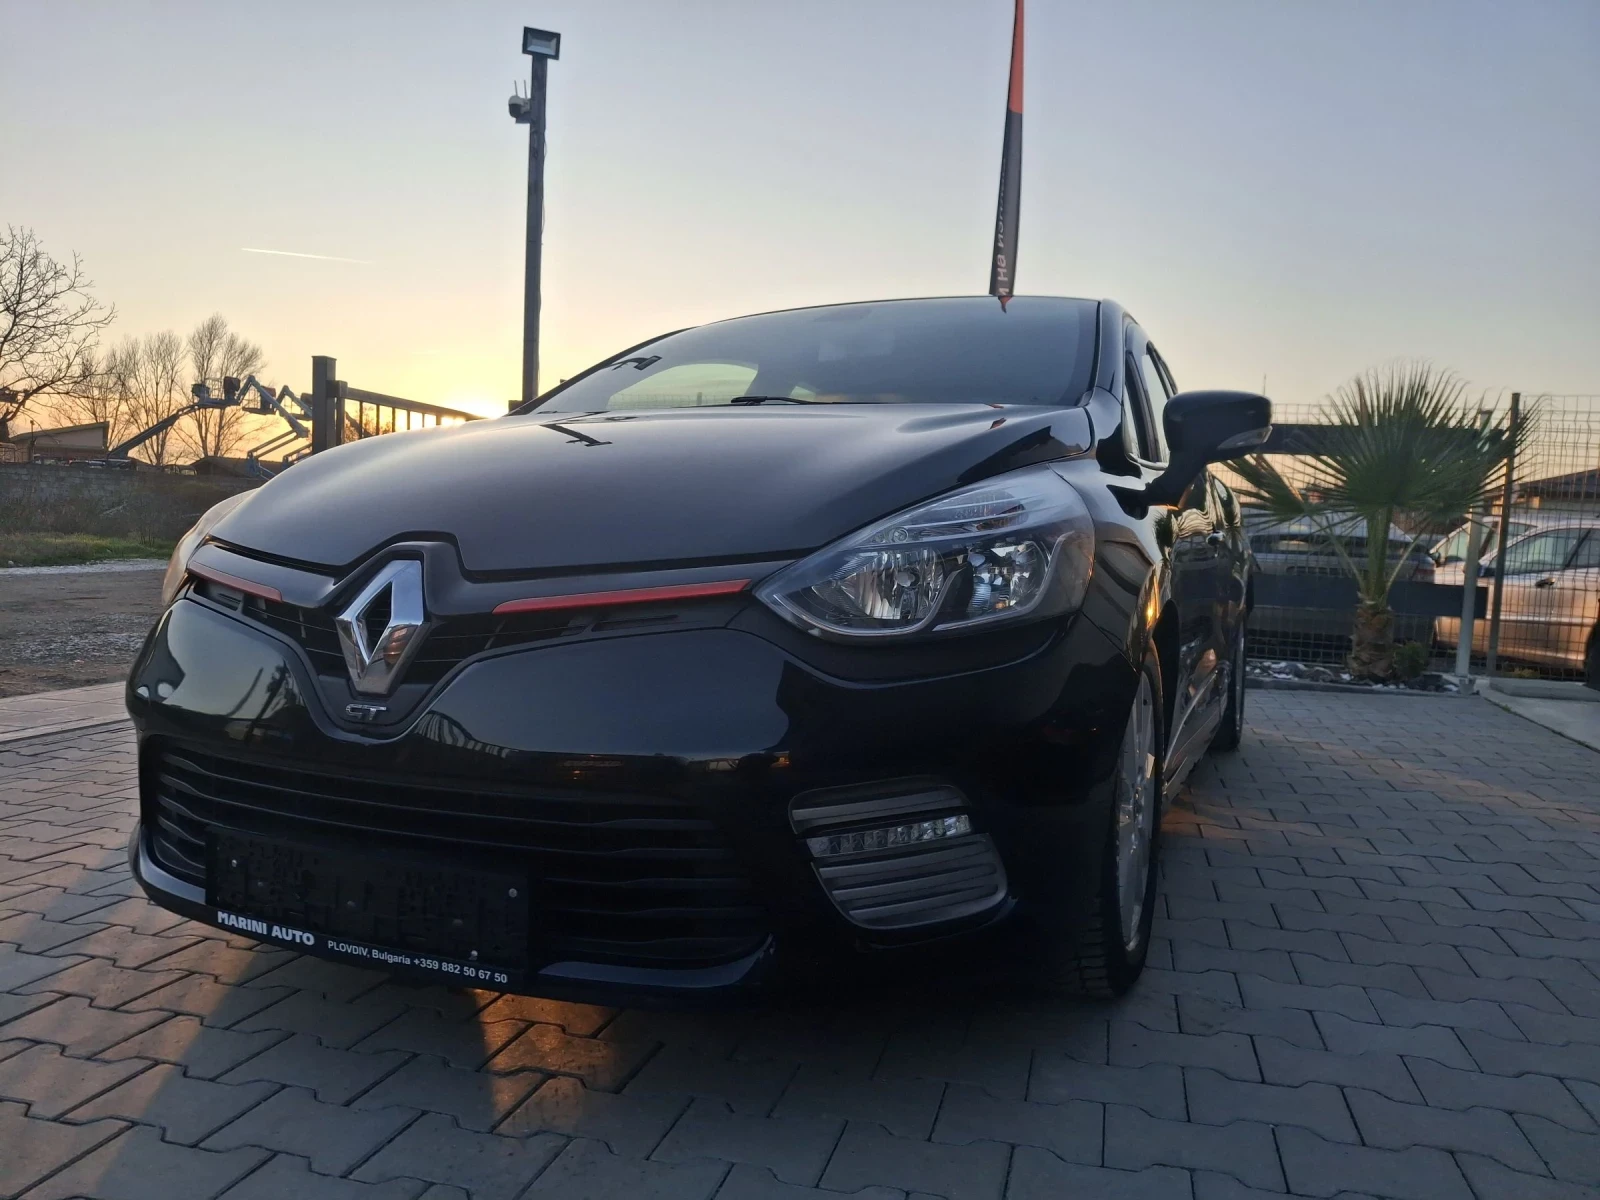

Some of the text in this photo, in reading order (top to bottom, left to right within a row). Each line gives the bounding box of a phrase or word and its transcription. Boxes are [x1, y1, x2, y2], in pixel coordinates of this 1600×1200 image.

[346, 704, 387, 721] GT
[217, 910, 315, 946] MARINI AUTO
[327, 940, 508, 984] PLOVDIV, Bulgaria +359 882 50 67 50
